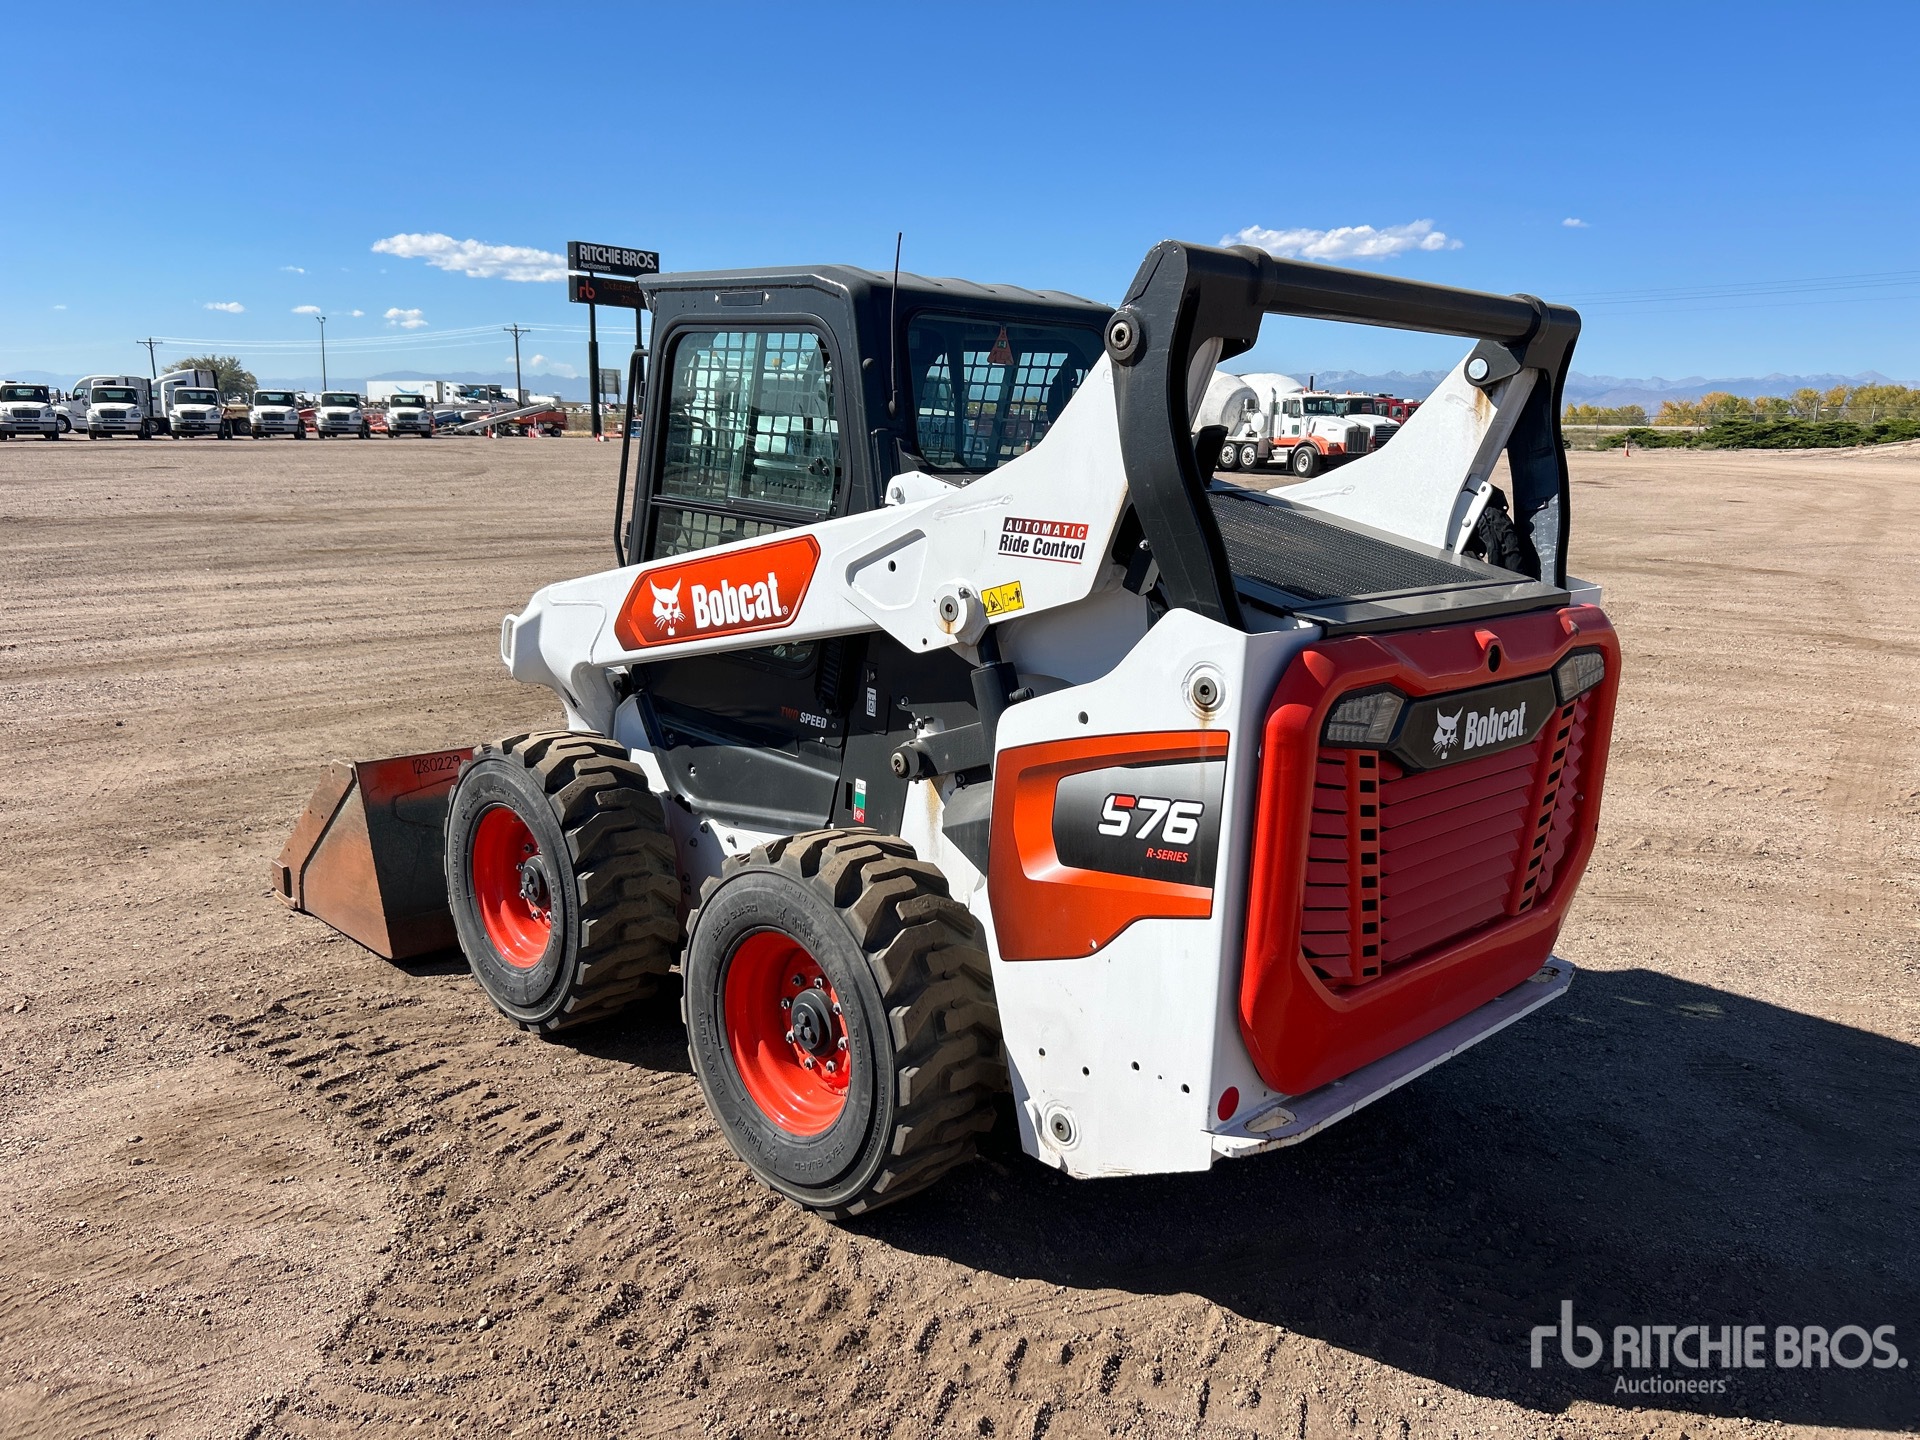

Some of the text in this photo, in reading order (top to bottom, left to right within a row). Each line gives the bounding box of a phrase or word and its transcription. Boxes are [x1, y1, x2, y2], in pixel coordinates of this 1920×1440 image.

[579, 244, 657, 270] RITCHIE BROS.
[580, 261, 611, 271] Auctioneers
[579, 279, 596, 300] rb
[1005, 519, 1086, 538] AUTOMATIC
[998, 534, 1086, 560] Ride Control
[780, 706, 828, 729] TWO SPEED
[1463, 701, 1526, 751] Bobcat
[412, 754, 462, 775] 1280229
[1097, 794, 1204, 845] S76
[1146, 847, 1189, 863] R-SERIES
